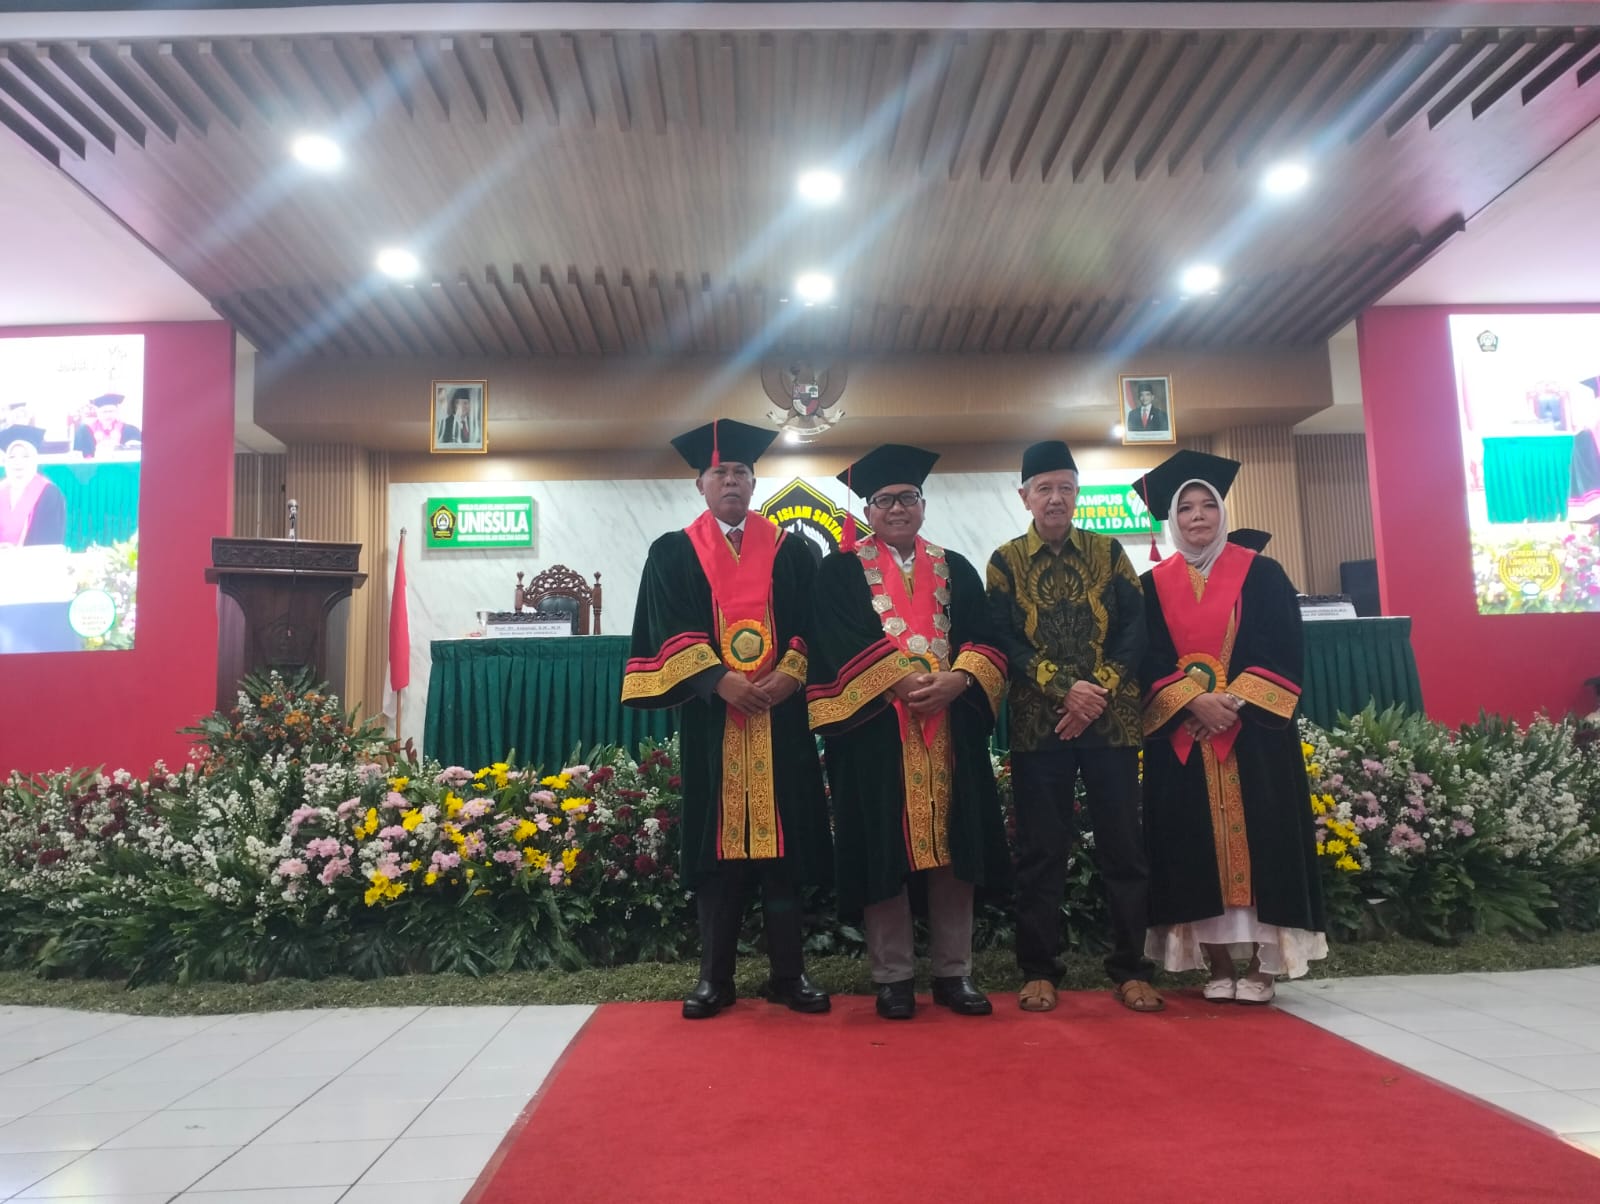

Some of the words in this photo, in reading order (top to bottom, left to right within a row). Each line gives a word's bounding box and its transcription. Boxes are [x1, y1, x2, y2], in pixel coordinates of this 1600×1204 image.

[1077, 494, 1123, 506] AMPUS
[457, 511, 529, 534] UNISSULA
[776, 505, 813, 522] ISLAM
[812, 508, 843, 543] SULTA
[1071, 516, 1151, 530] WALIDAIN
